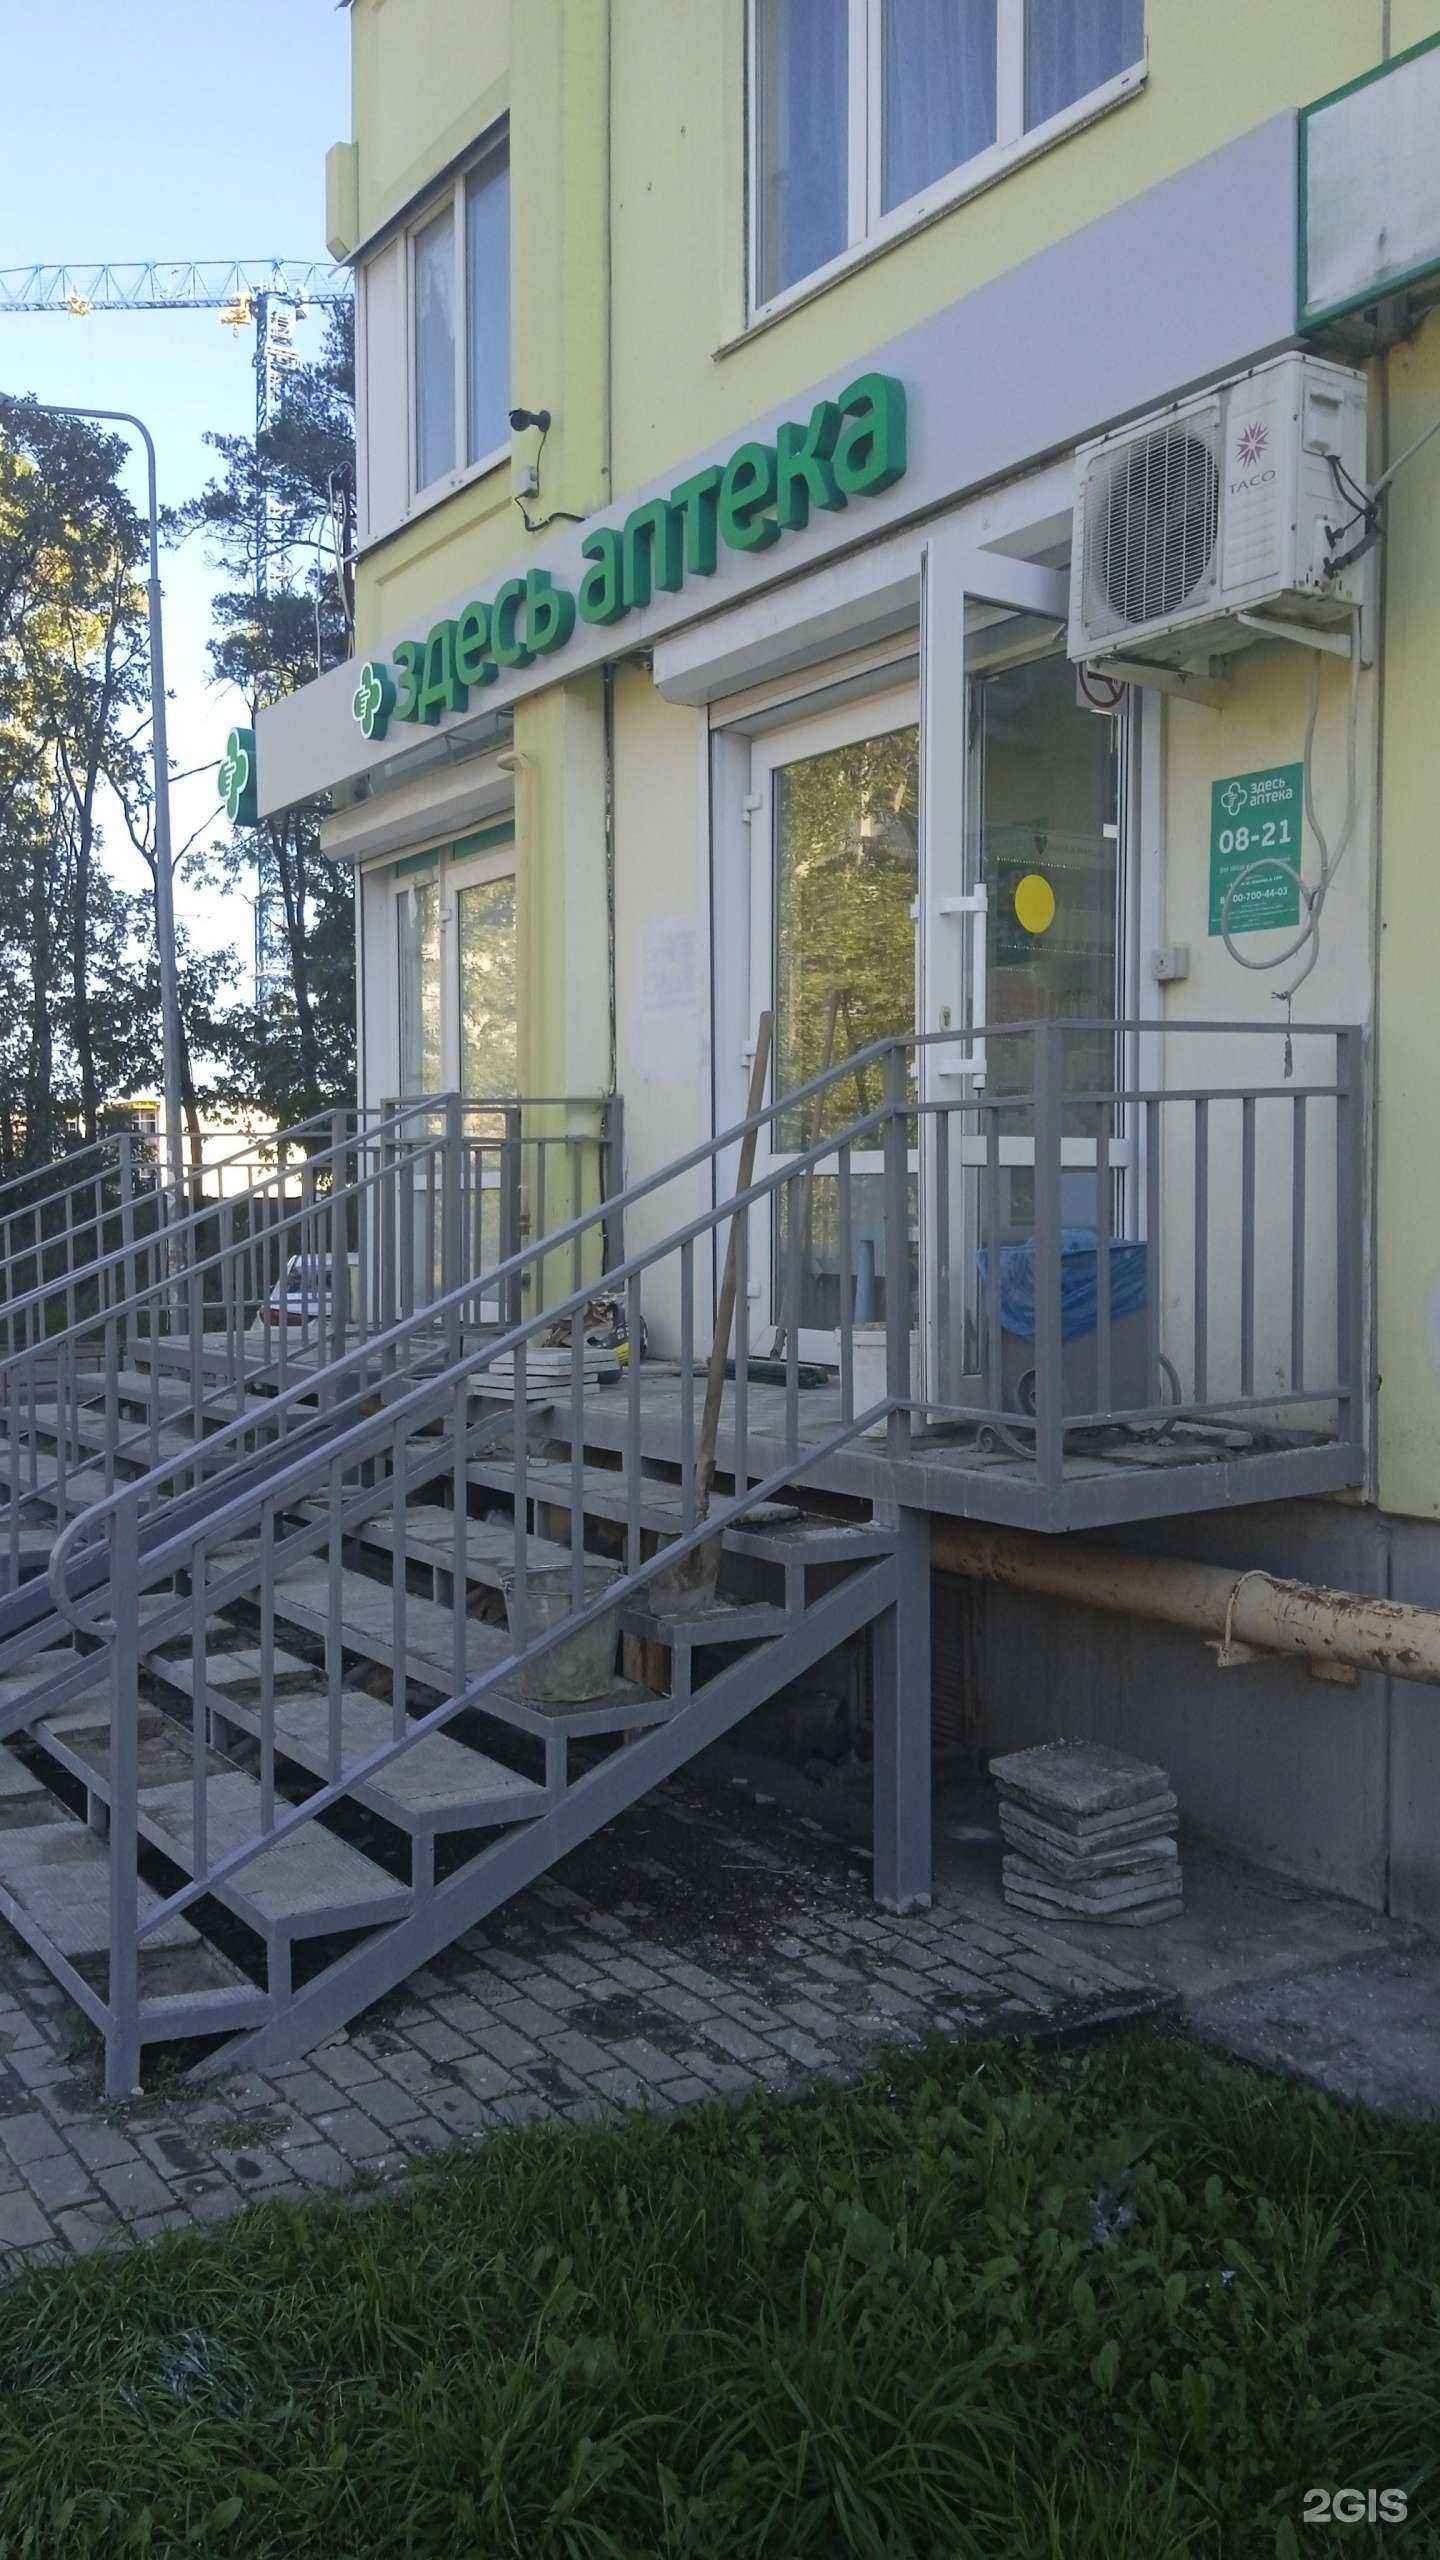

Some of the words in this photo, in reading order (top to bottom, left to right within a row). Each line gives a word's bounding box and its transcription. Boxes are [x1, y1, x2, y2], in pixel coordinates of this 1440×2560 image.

[1229, 471, 1276, 494] TACO
[391, 569, 576, 725] здесь
[581, 372, 907, 626] аптека
[1249, 778, 1286, 794] здесь
[1250, 787, 1293, 807] аптека
[1219, 819, 1291, 854] 08-21
